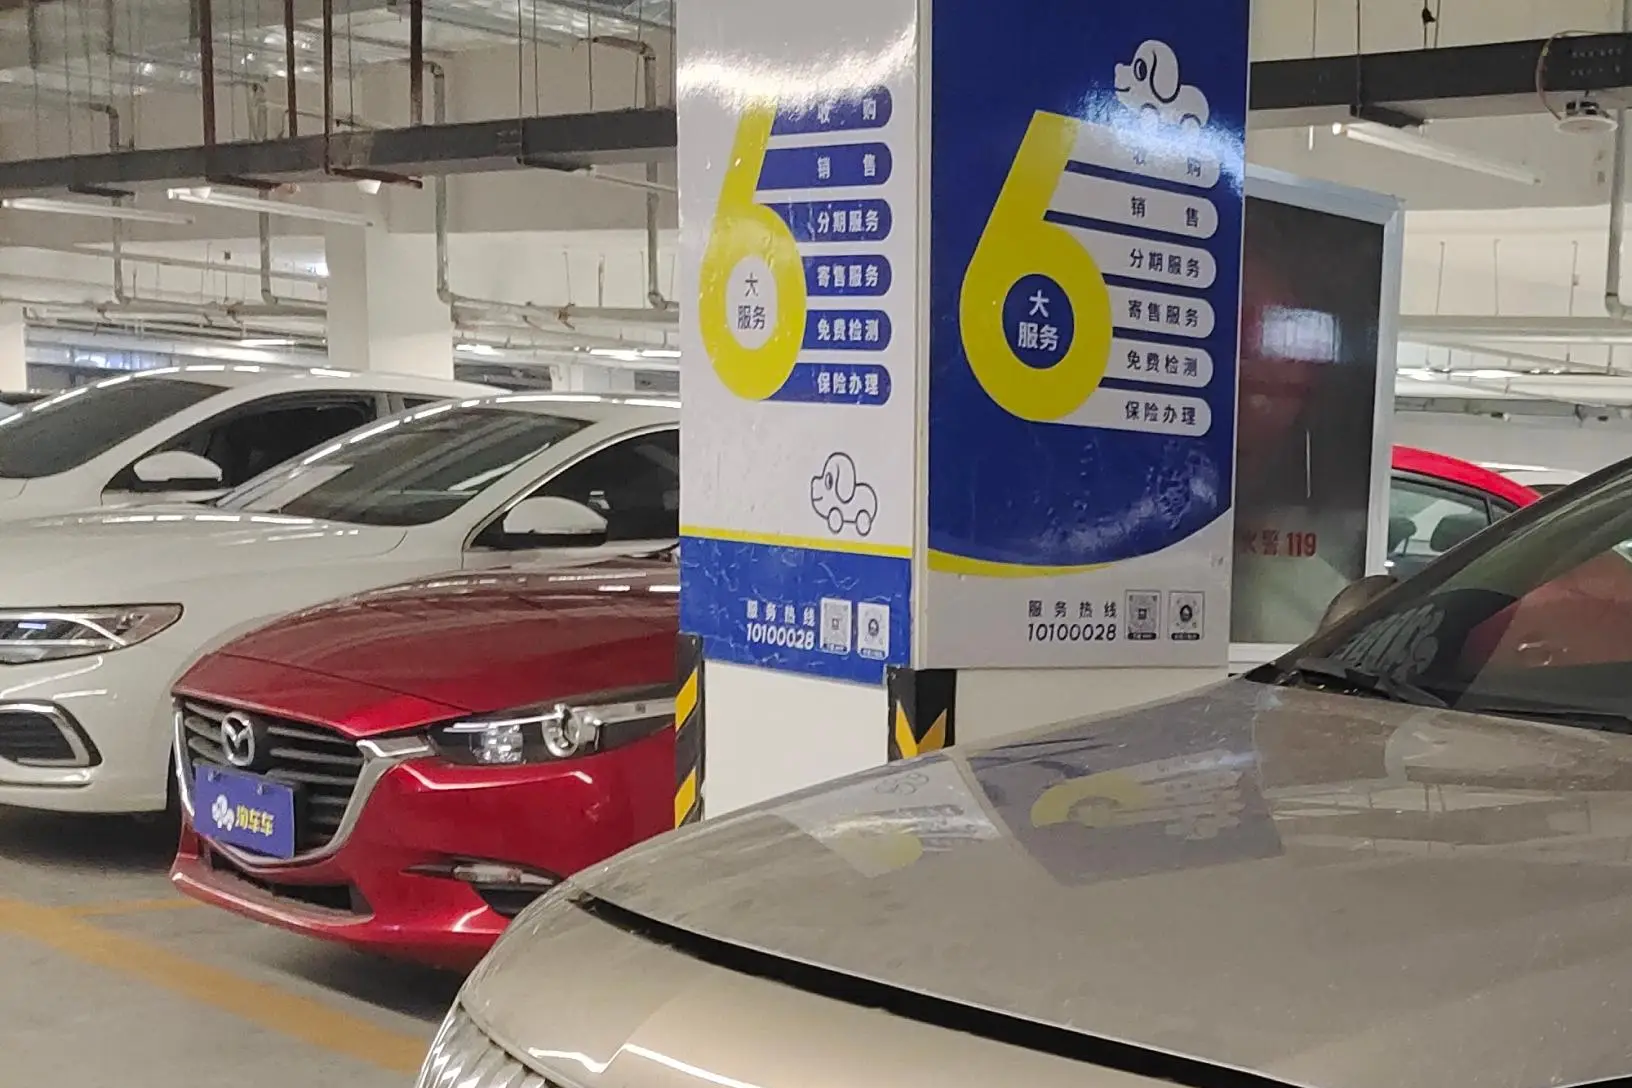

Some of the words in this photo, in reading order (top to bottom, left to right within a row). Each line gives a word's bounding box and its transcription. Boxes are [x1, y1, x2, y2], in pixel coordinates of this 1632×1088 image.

[816, 154, 876, 179] 销售
[816, 209, 879, 234] 分期服务
[1130, 195, 1200, 229] 销售
[816, 264, 879, 289] 寄售服务
[959, 109, 1112, 423] 6
[1129, 247, 1200, 279] 分期服务
[744, 272, 759, 298] 大
[736, 304, 767, 331] 服务
[1028, 289, 1051, 319] 大
[1127, 299, 1200, 328] 寄售服务
[816, 318, 879, 342] 免费检测
[1017, 321, 1060, 352] 服务
[1126, 349, 1199, 379] 免费检测
[816, 371, 879, 396] 保险办理
[1124, 400, 1197, 426] 保险办理
[1286, 530, 1317, 557] 119
[746, 599, 816, 627] 服务热线
[1027, 600, 1118, 620] 服务热线
[746, 622, 816, 651] 10100028
[1027, 623, 1118, 642] 10100028
